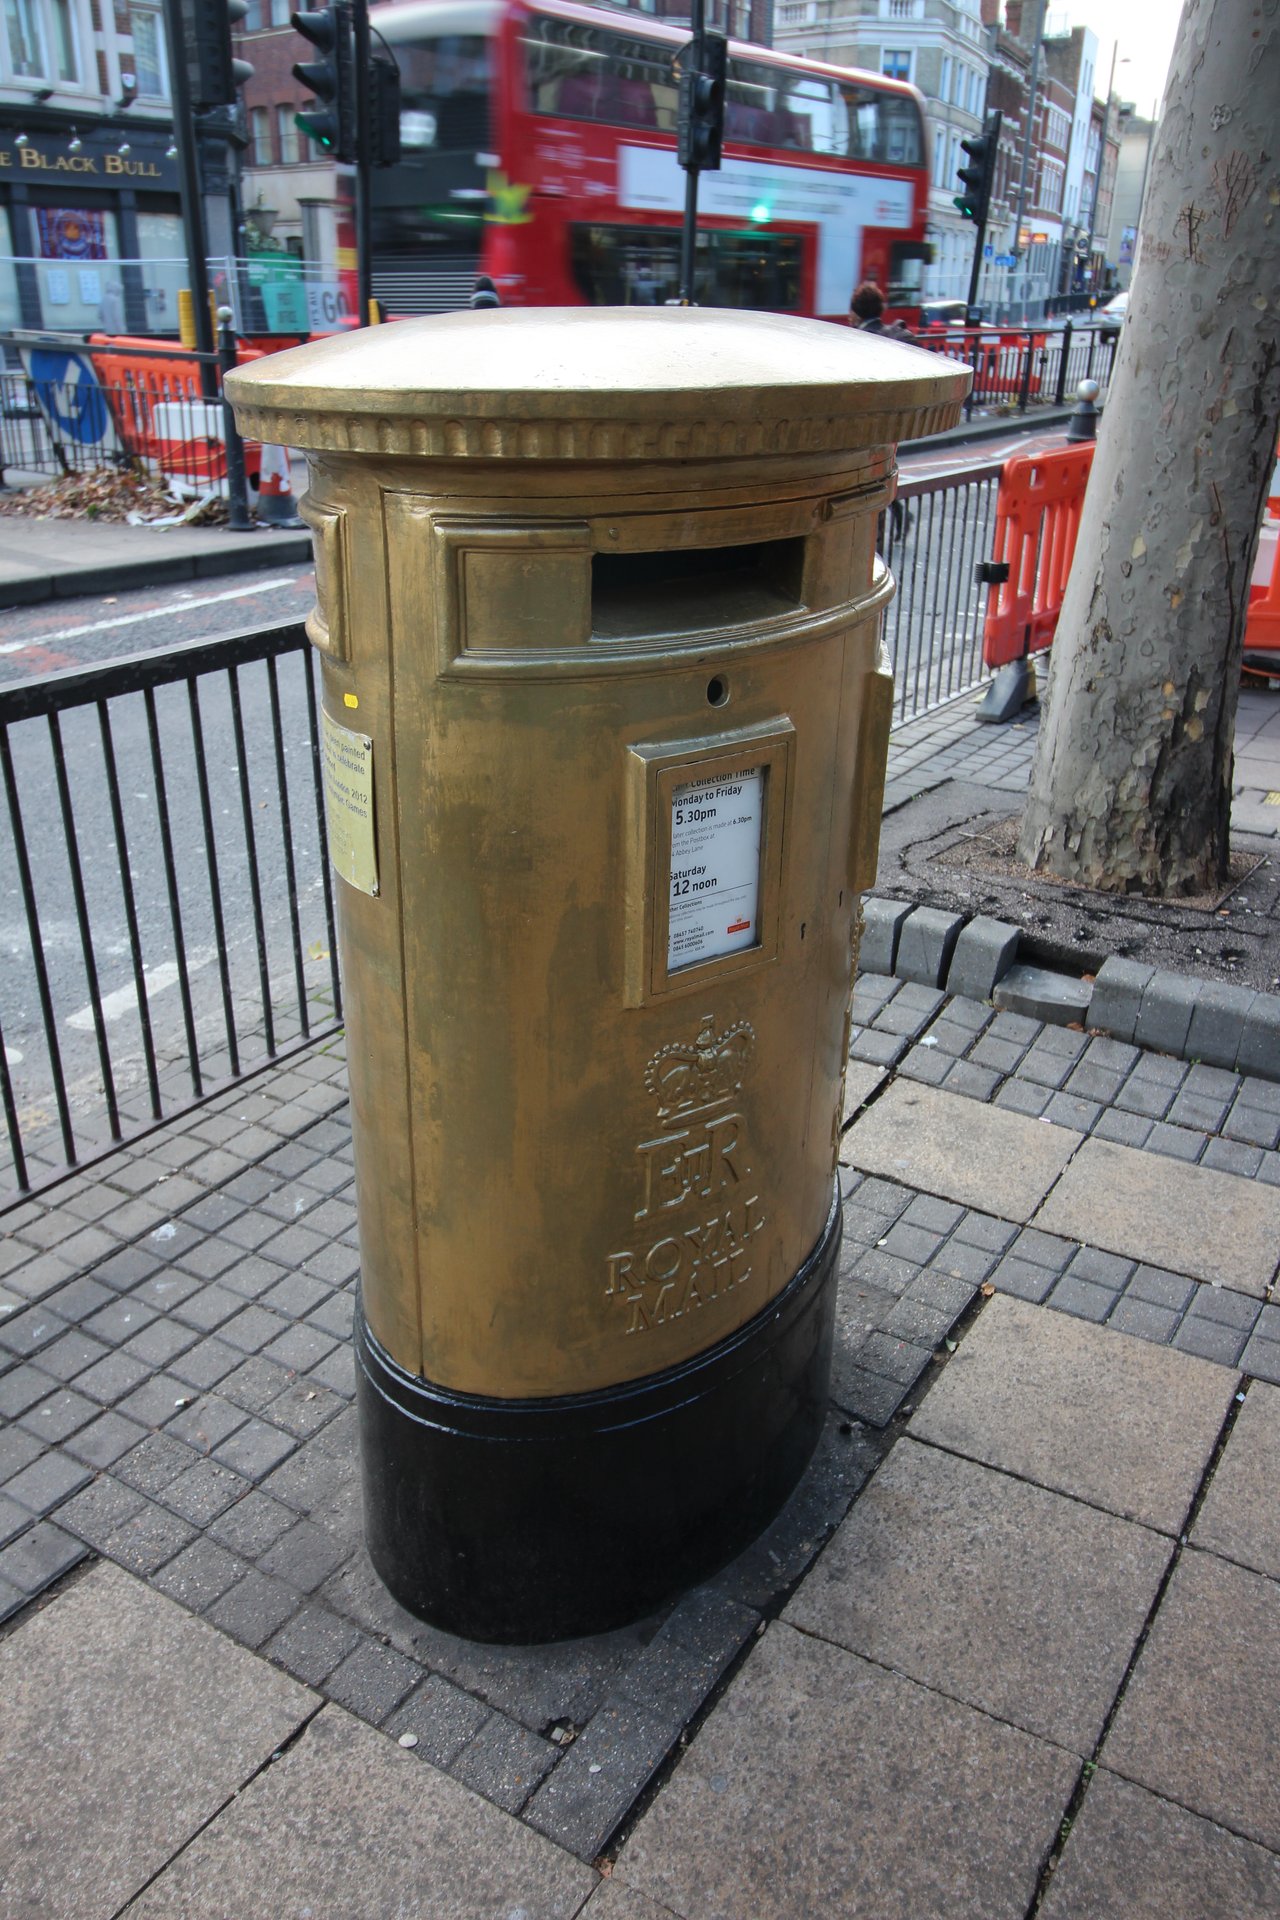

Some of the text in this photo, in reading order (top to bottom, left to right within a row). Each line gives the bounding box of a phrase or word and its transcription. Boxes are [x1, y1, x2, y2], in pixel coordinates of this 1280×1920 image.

[20, 148, 99, 174] BLACK
[104, 155, 162, 177] BULL
[341, 743, 366, 760] painted
[336, 754, 365, 775] celebrate
[351, 788, 368, 804] 2012
[705, 792, 714, 800] to
[715, 785, 743, 798] Friday
[345, 799, 368, 819] Games
[675, 808, 717, 826] 5.30pm
[732, 816, 753, 825] 6.30pm
[689, 835, 710, 845] Postbox
[675, 848, 691, 857] Abbey
[691, 845, 704, 853] Lane
[673, 878, 717, 897] 12 noon
[605, 1195, 766, 1295] ROYAL
[626, 1248, 752, 1335] MAIL
